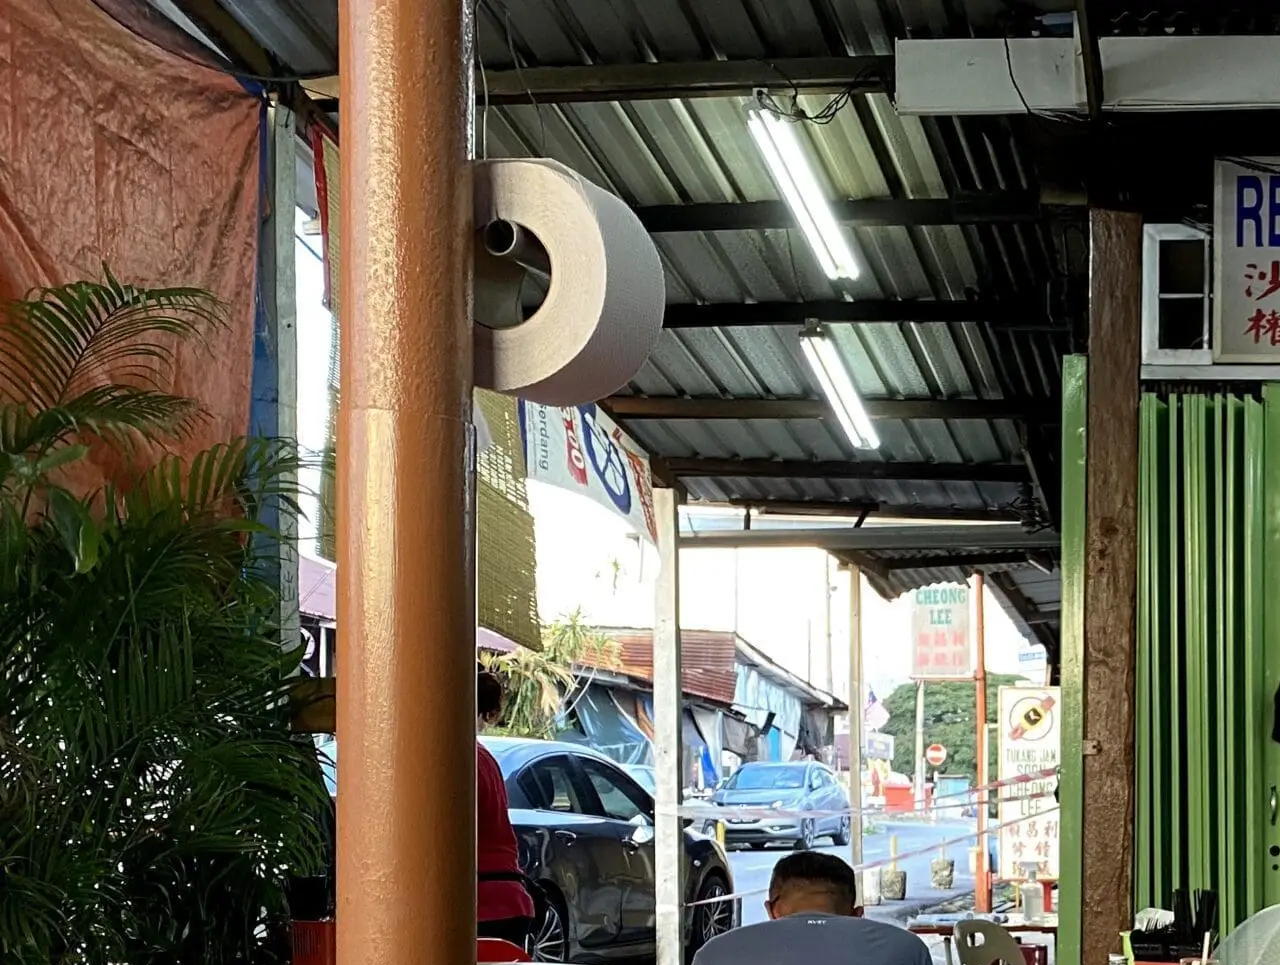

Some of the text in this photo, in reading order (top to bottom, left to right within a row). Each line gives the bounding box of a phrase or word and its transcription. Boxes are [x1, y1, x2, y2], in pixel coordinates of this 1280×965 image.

[915, 587, 966, 605] CHEONG
[930, 608, 953, 625] LEE
[1006, 747, 1057, 763] TUKANG JAM
[1020, 799, 1042, 817] LEE
